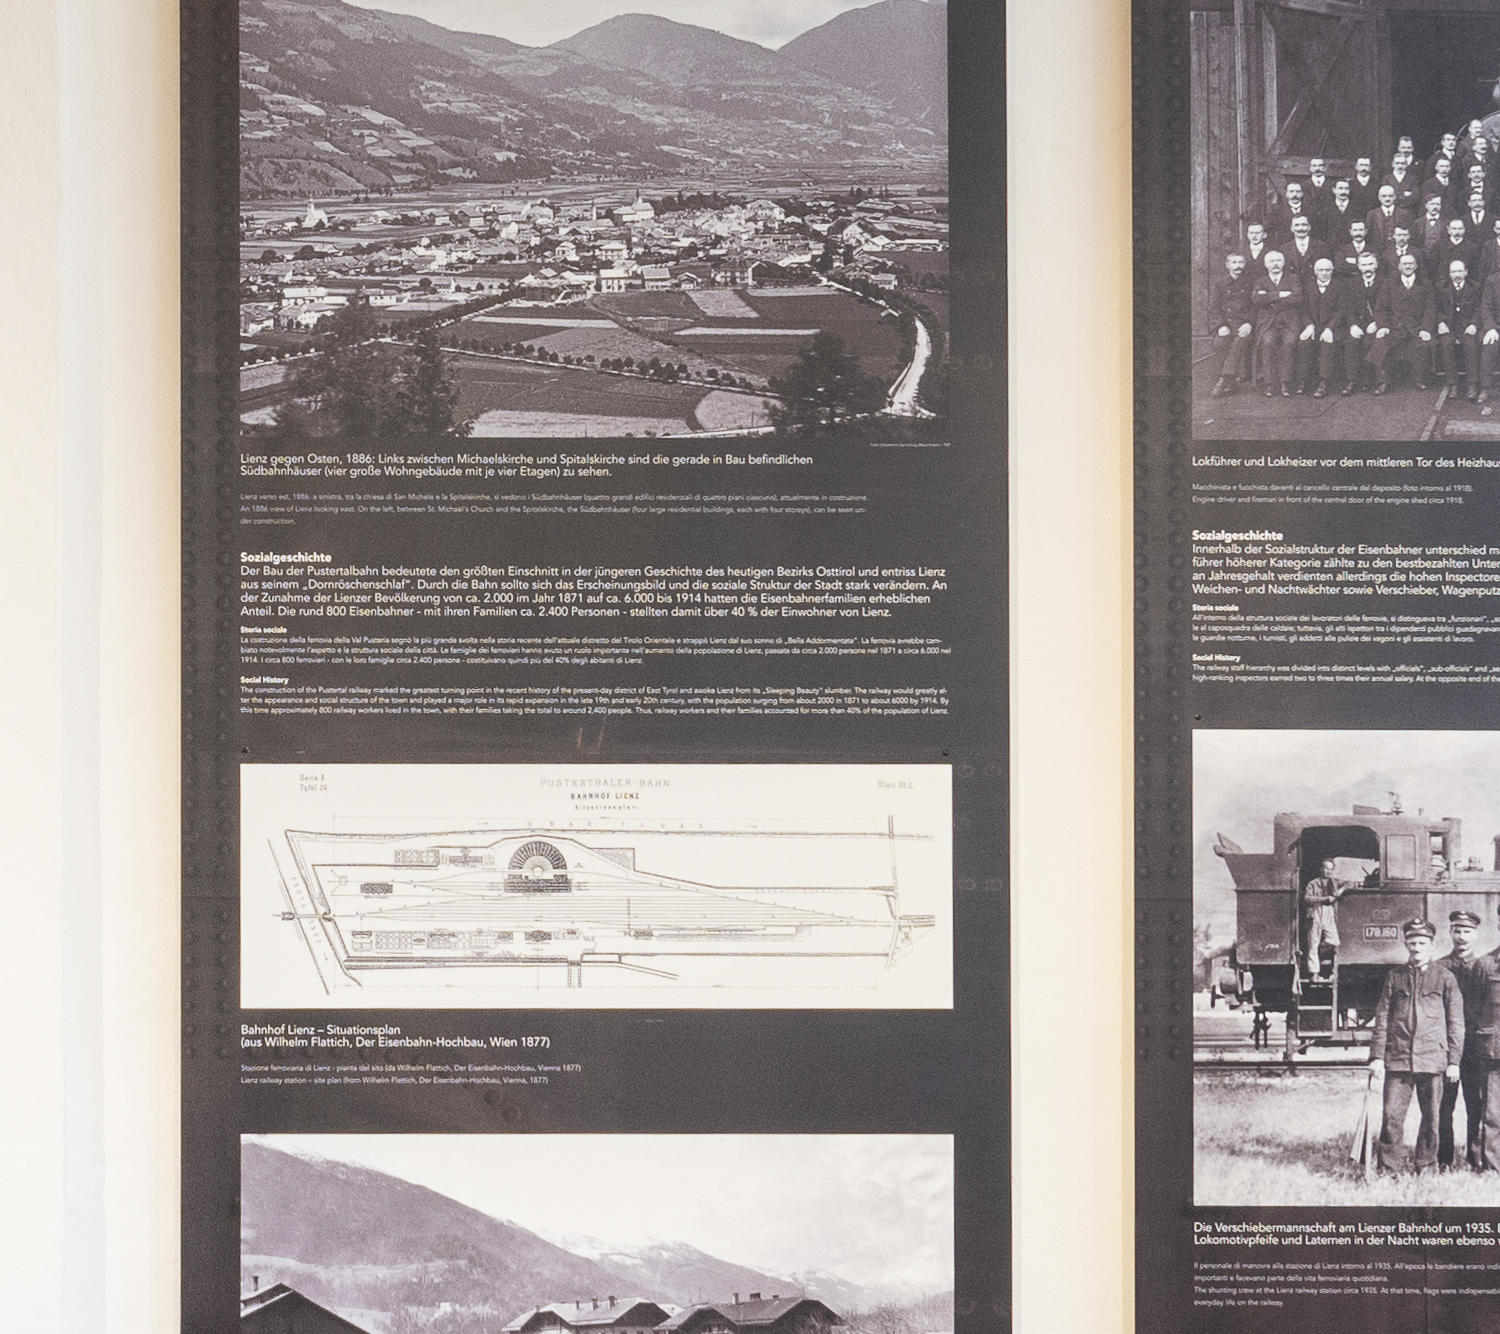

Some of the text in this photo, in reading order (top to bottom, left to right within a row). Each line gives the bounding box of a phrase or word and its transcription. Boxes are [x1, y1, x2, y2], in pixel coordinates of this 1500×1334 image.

[241, 452, 267, 463] Lienz
[270, 455, 304, 466] gegen
[378, 453, 404, 464] Links
[407, 453, 456, 464] zwischen
[457, 453, 533, 464] Michaelskirche
[537, 453, 558, 464] und
[560, 453, 625, 467] Spitalskirche
[628, 453, 650, 464] sind
[652, 453, 669, 464] die
[672, 453, 710, 467] gerade
[713, 453, 722, 464] in
[726, 453, 745, 464] Bau
[748, 453, 813, 464] befindlichen
[240, 464, 322, 476] Südbahnhäuser
[325, 464, 347, 478] (vier
[350, 465, 381, 478] große
[384, 465, 462, 479] Wohngebäude
[465, 465, 482, 476] mit
[485, 465, 494, 479] je
[498, 465, 517, 476] vier
[520, 465, 560, 479] Etagen)
[563, 468, 574, 476] zu
[1192, 529, 1283, 543] Sozialgeschichte
[240, 551, 332, 565] Sozialgeschichte
[241, 1023, 285, 1035] Bahnhof
[288, 1023, 315, 1035] Lienz
[327, 1023, 400, 1037] Situationsplan
[241, 1036, 262, 1049] (aus
[264, 1036, 308, 1047] Wilhelm
[356, 1036, 376, 1047] Der
[489, 1036, 517, 1047] Wien
[521, 1036, 550, 1049] 1877)
